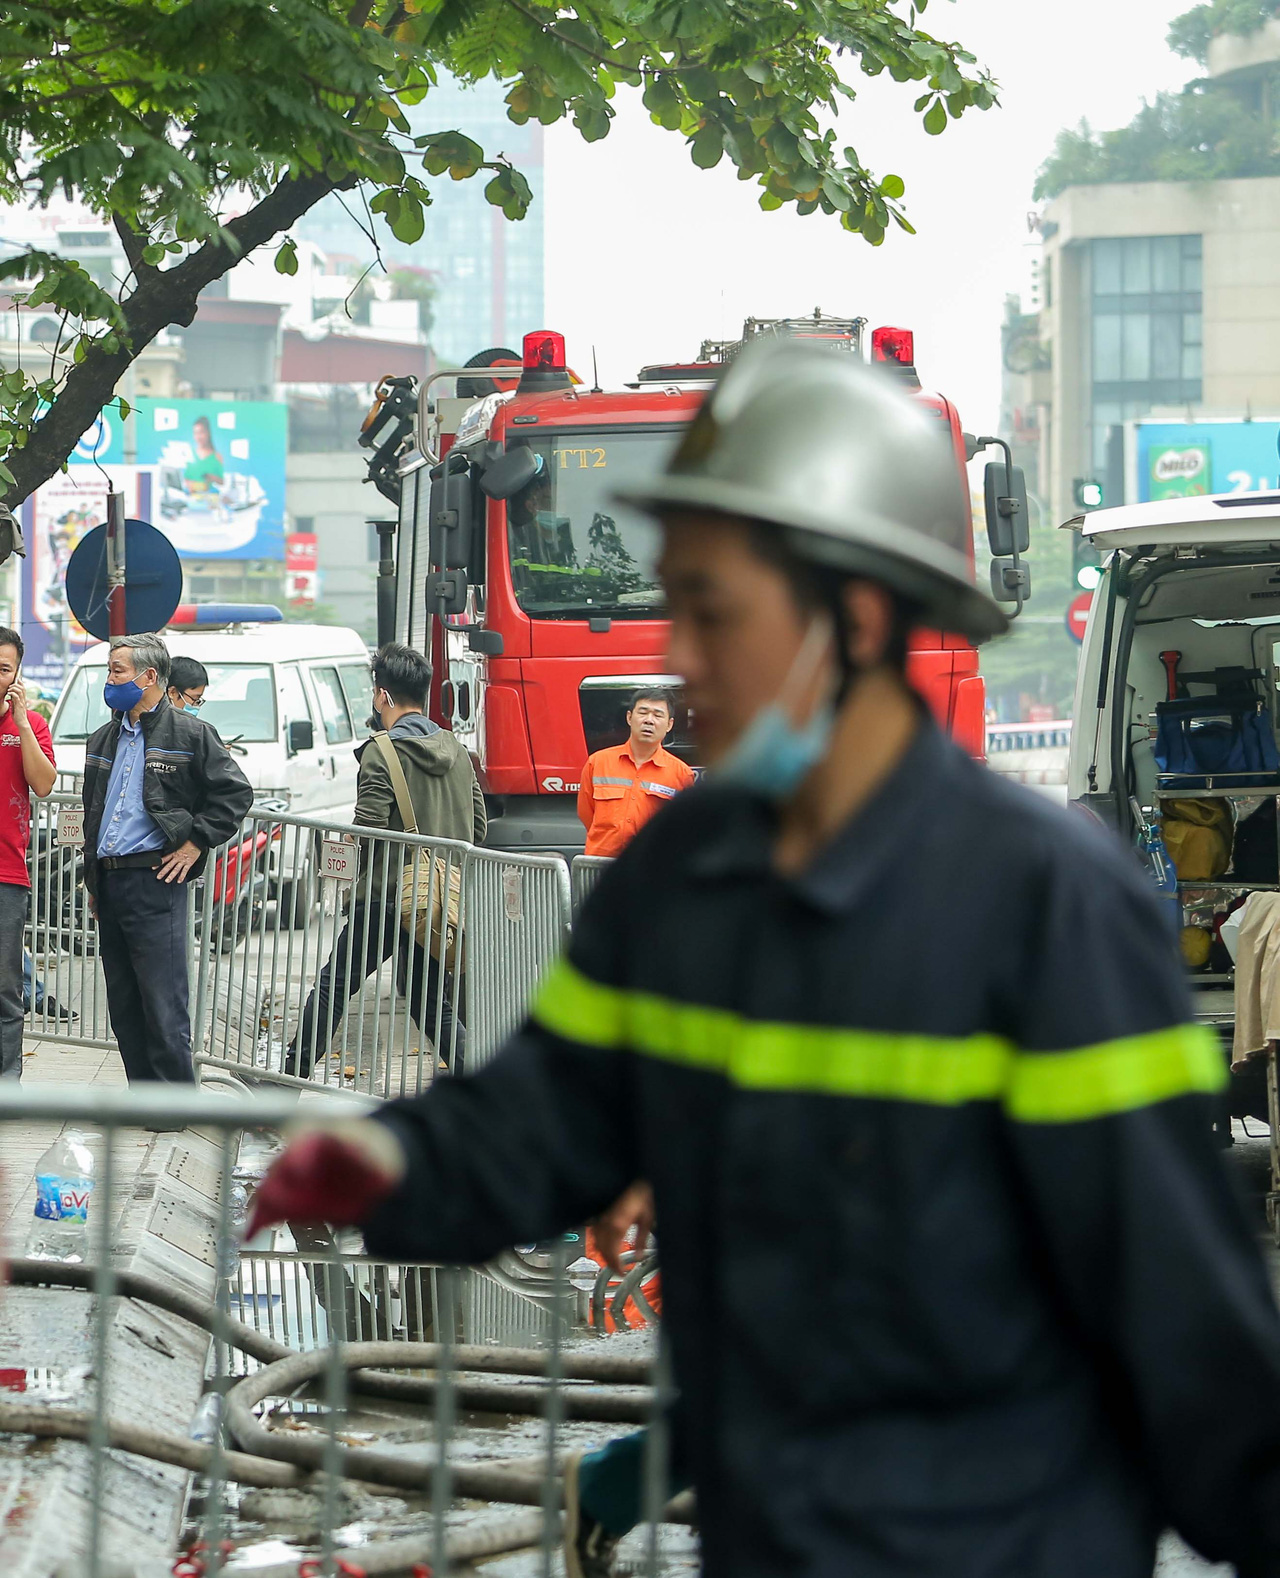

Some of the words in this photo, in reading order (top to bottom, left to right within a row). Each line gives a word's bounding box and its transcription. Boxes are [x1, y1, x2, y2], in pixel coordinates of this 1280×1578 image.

[553, 447, 607, 469] TT2
[63, 826, 80, 837] STOP
[330, 845, 345, 855] POLICE
[327, 858, 347, 872] STOP
